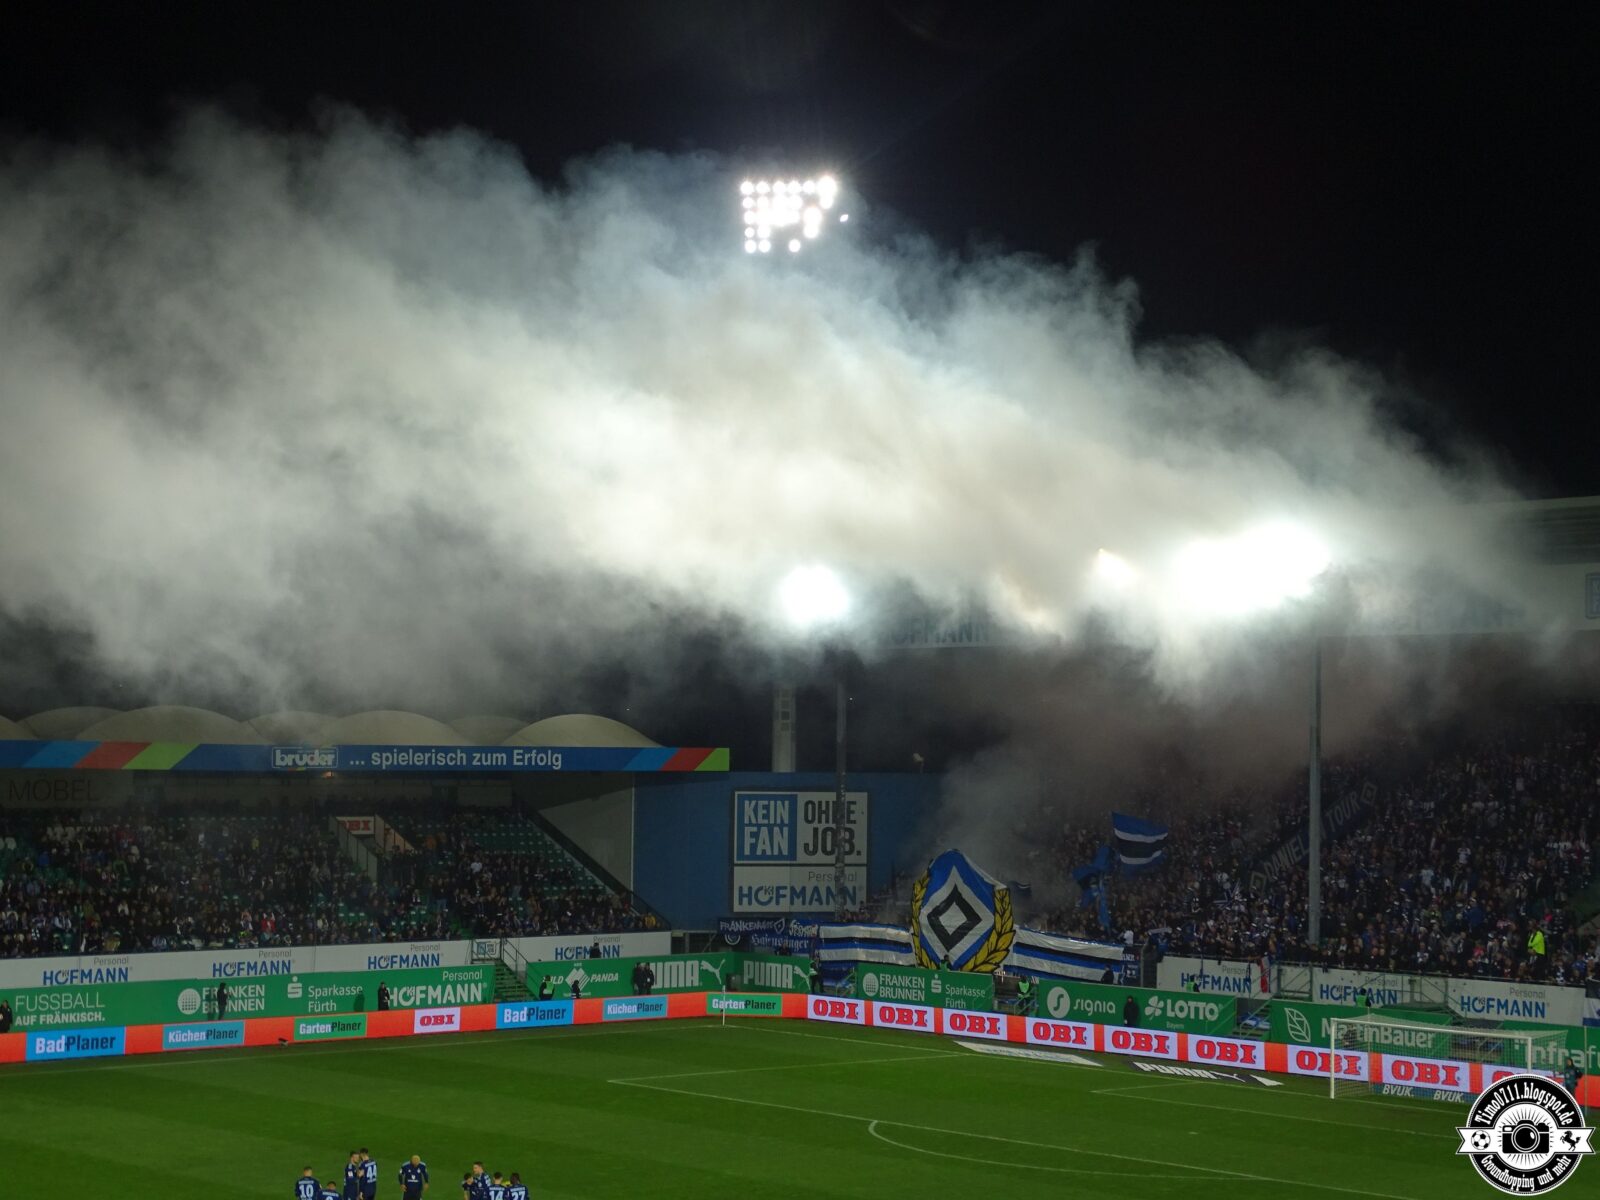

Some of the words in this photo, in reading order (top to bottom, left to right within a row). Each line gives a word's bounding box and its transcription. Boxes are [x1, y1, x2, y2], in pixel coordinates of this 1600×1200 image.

[275, 749, 335, 766] bruder
[371, 749, 467, 769] spielerisch
[472, 752, 507, 766] zum
[512, 749, 562, 770] Erfolg
[744, 800, 789, 824] KEIN
[803, 800, 857, 824] OHE
[743, 826, 789, 856] FAN
[258, 950, 292, 959] Personal
[410, 943, 441, 951] Personal
[555, 944, 620, 961] HOFMNN
[93, 957, 129, 966] Personal
[212, 960, 291, 978] HOFMANN
[367, 953, 440, 970] HOFMANN
[43, 967, 129, 986] HOFMANN
[443, 968, 482, 982] Personal
[590, 972, 619, 983] PANDA
[640, 960, 700, 989] UMA
[743, 960, 793, 989] PUMA
[879, 973, 925, 989] FRANKEN
[308, 985, 364, 999] Sparkasse
[388, 983, 482, 1007] HOFMANN
[879, 988, 925, 1002] BRUNNEN
[945, 984, 986, 998] Sparkasse
[1509, 987, 1545, 998] Personal
[15, 992, 106, 1012] FUSSBALL
[202, 998, 265, 1014] BRNNEN
[308, 1000, 337, 1012] Fürth
[607, 1003, 663, 1015] KüchenPlaner
[712, 998, 776, 1010] GartenPlaner
[813, 999, 858, 1020] OBI
[945, 1000, 966, 1009] Fürth
[1073, 998, 1116, 1017] signia
[1460, 995, 1545, 1019] HOFMANN
[15, 1014, 37, 1026] AUF
[40, 1011, 106, 1024] FRÄNKISCH.
[419, 1014, 454, 1026] OBI
[503, 1006, 566, 1023] BadPlaner
[879, 1006, 927, 1027] OBI
[1166, 1002, 1219, 1022] LOTTO
[299, 1021, 362, 1035] GartenPlaner
[949, 1013, 1000, 1035] OBI
[168, 1030, 239, 1044] KüchenPlaner
[1032, 1022, 1087, 1045] OBI
[1111, 1030, 1169, 1054] OBI
[35, 1034, 116, 1054] BadPlaner
[1196, 1039, 1256, 1064] OBI
[1296, 1050, 1361, 1075] OBI
[1391, 1060, 1459, 1086] OBI
[366, 1164, 377, 1180] 44
[299, 1184, 314, 1198] 10
[489, 1190, 504, 1200] 14
